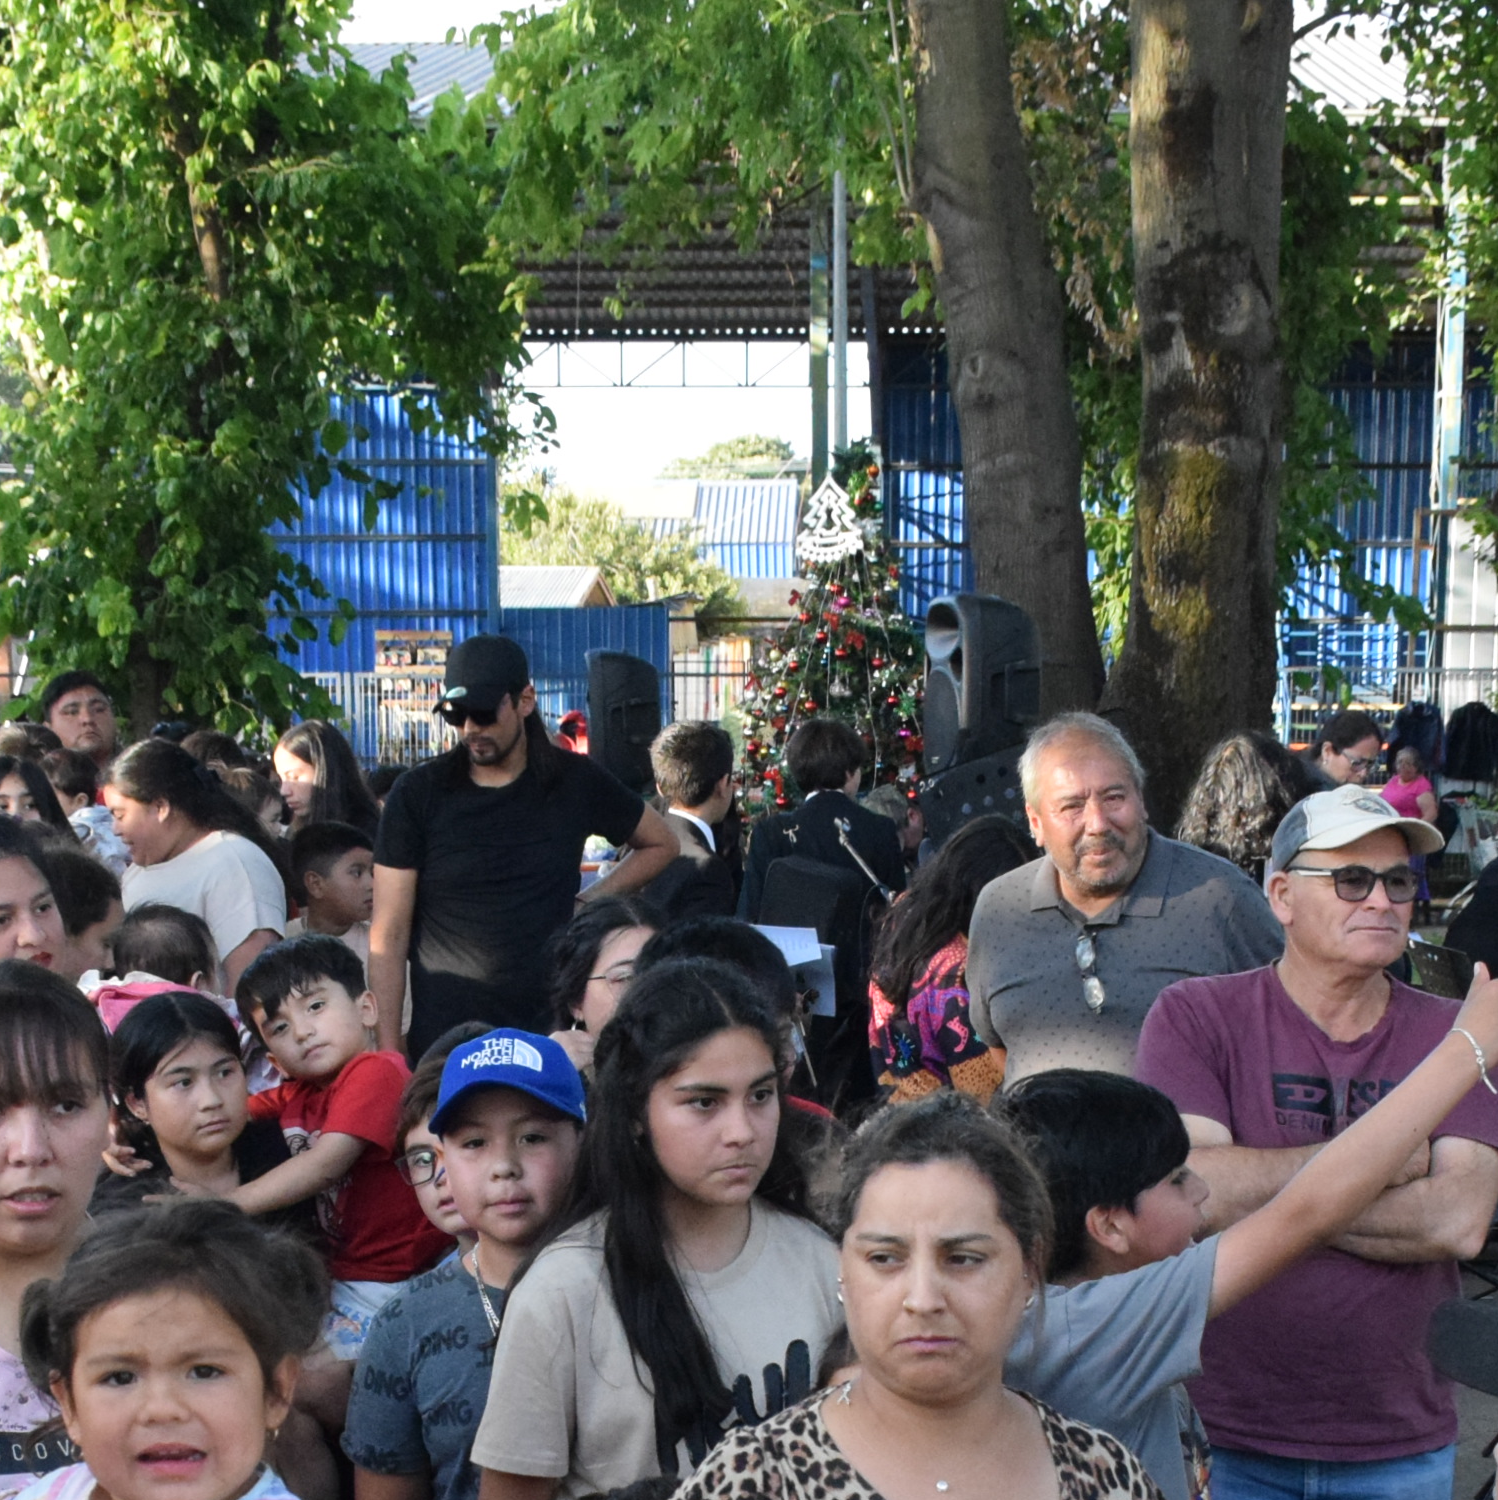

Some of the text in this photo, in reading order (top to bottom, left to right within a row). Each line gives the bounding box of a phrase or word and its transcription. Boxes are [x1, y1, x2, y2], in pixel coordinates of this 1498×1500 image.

[482, 1037, 514, 1047] THE
[461, 1046, 514, 1068] NORTH
[473, 1055, 512, 1070] FACE
